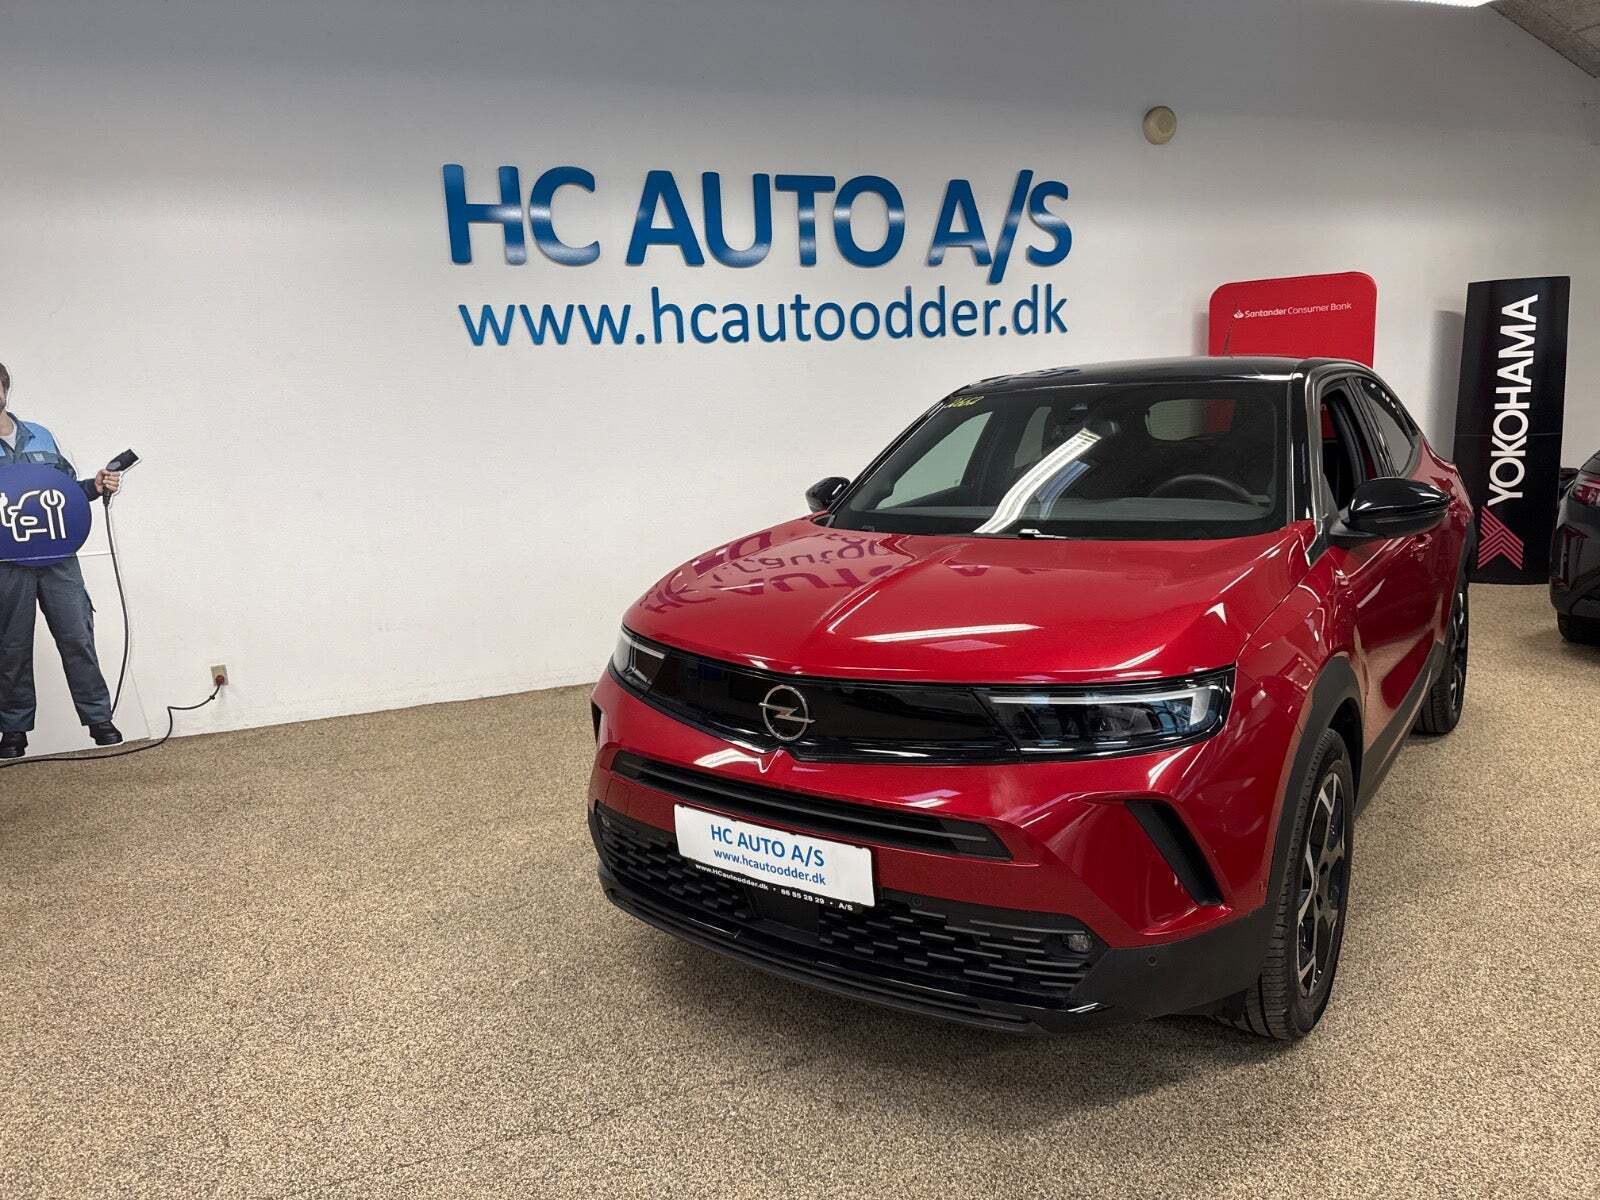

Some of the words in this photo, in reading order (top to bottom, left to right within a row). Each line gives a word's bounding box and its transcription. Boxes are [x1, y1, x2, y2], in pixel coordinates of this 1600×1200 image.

[442, 164, 600, 265] HC
[625, 170, 906, 268] AUTO
[926, 169, 1073, 284] A/S
[458, 283, 1069, 346] www.hcautoodder.dk
[1244, 308, 1286, 319] Santander
[1287, 305, 1329, 315] Consumer
[1330, 301, 1352, 311] Bank
[1488, 294, 1539, 506] YOKOHAMA
[710, 824, 733, 845] HC
[737, 832, 785, 858] AUTO
[791, 845, 825, 867] A/S
[713, 849, 826, 886] www.hcautoodder.dk
[838, 902, 853, 911] A/S
